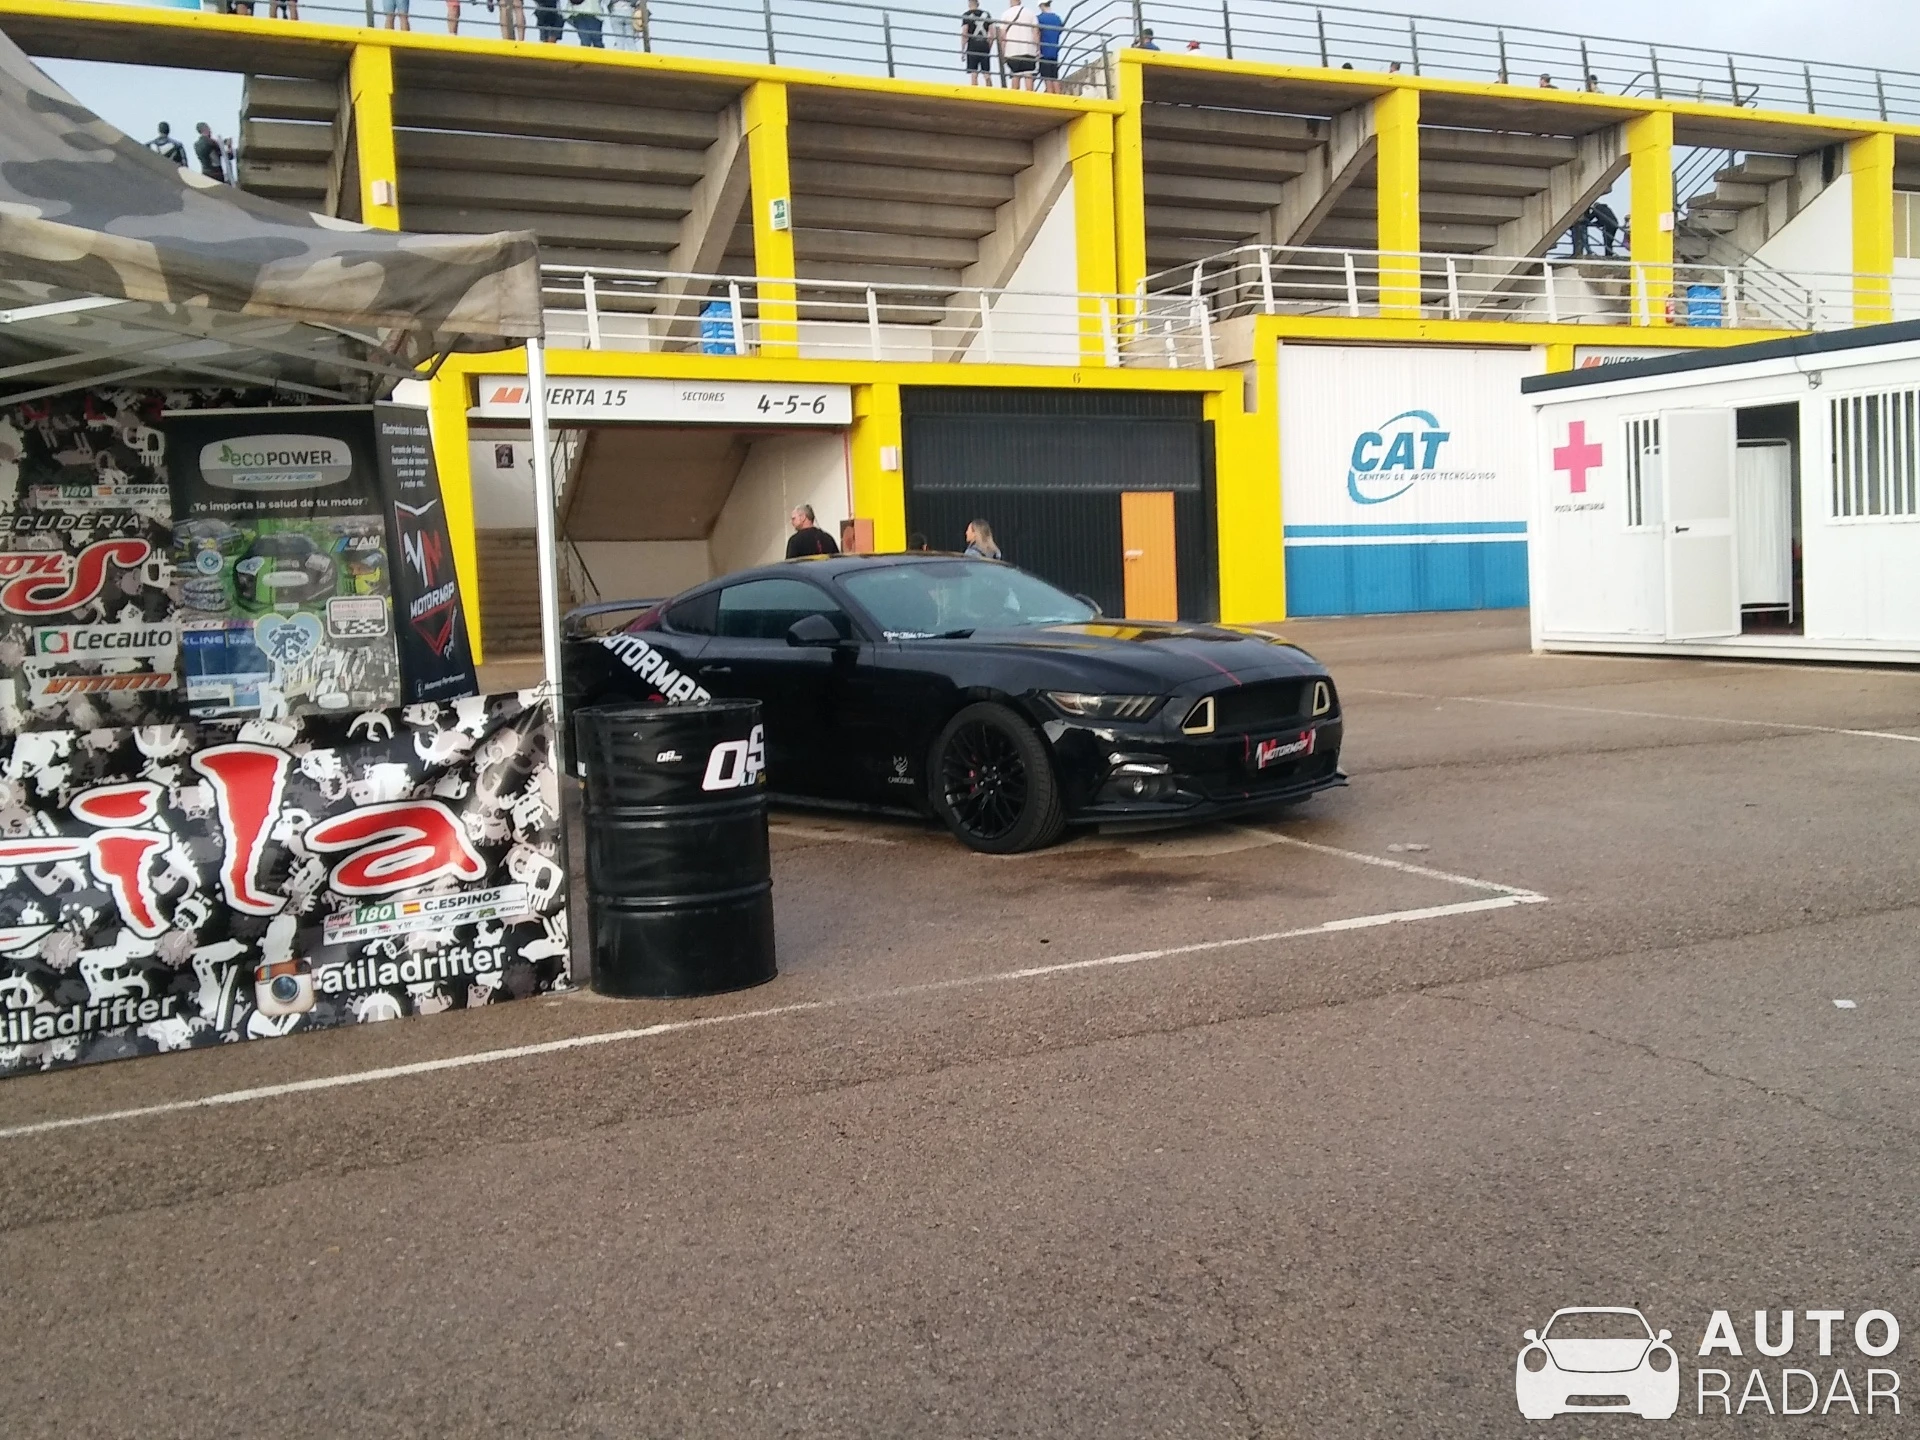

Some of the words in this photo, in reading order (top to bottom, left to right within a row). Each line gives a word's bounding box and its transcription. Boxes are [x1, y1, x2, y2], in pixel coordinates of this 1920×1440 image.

[525, 388, 594, 405] ERTA
[602, 390, 627, 407] 15
[682, 391, 725, 402] SECTORES
[757, 395, 826, 414] 4-5-6
[231, 451, 332, 467] ecoPOWER
[1351, 431, 1451, 472] CAT
[64, 486, 91, 497] 180
[209, 501, 253, 513] importa
[256, 501, 266, 510] la
[268, 499, 297, 509] salud
[300, 499, 314, 508] de
[316, 498, 328, 507] tu
[73, 630, 173, 650] Cecauto
[360, 904, 392, 922] 180
[424, 890, 501, 911] C.ESPINOS
[322, 946, 507, 993] atiladrifter
